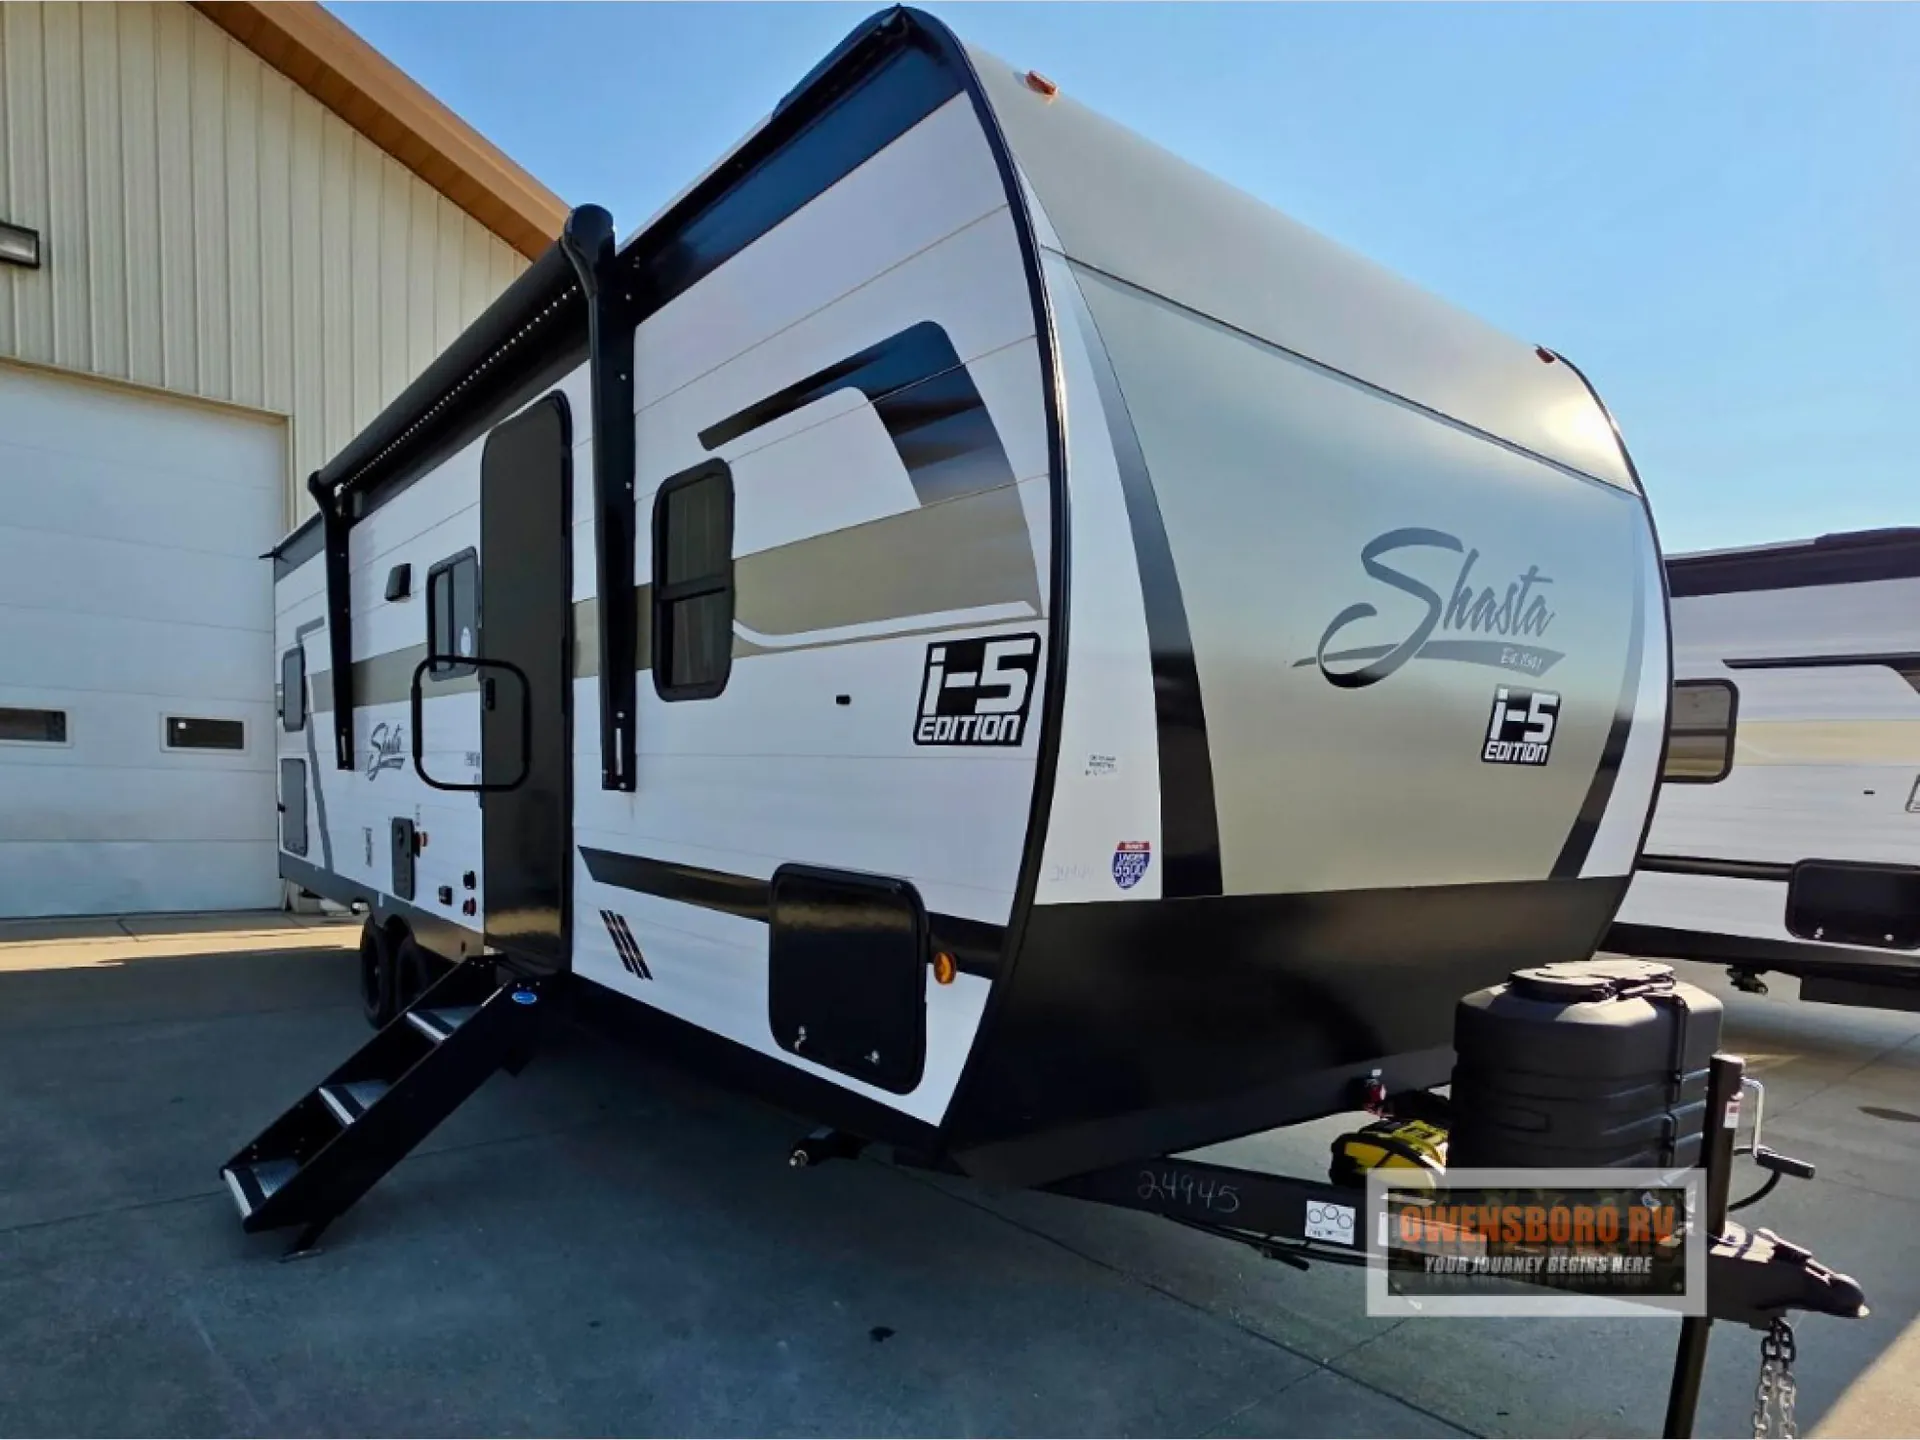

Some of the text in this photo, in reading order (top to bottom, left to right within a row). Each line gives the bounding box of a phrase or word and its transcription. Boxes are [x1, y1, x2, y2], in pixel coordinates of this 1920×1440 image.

[1317, 527, 1557, 688] Shasta
[923, 641, 1035, 716] i-5
[917, 713, 1021, 743] EDITION
[1491, 688, 1557, 742] i-5
[1484, 740, 1548, 763] EDITION
[1136, 1170, 1241, 1214] 24945
